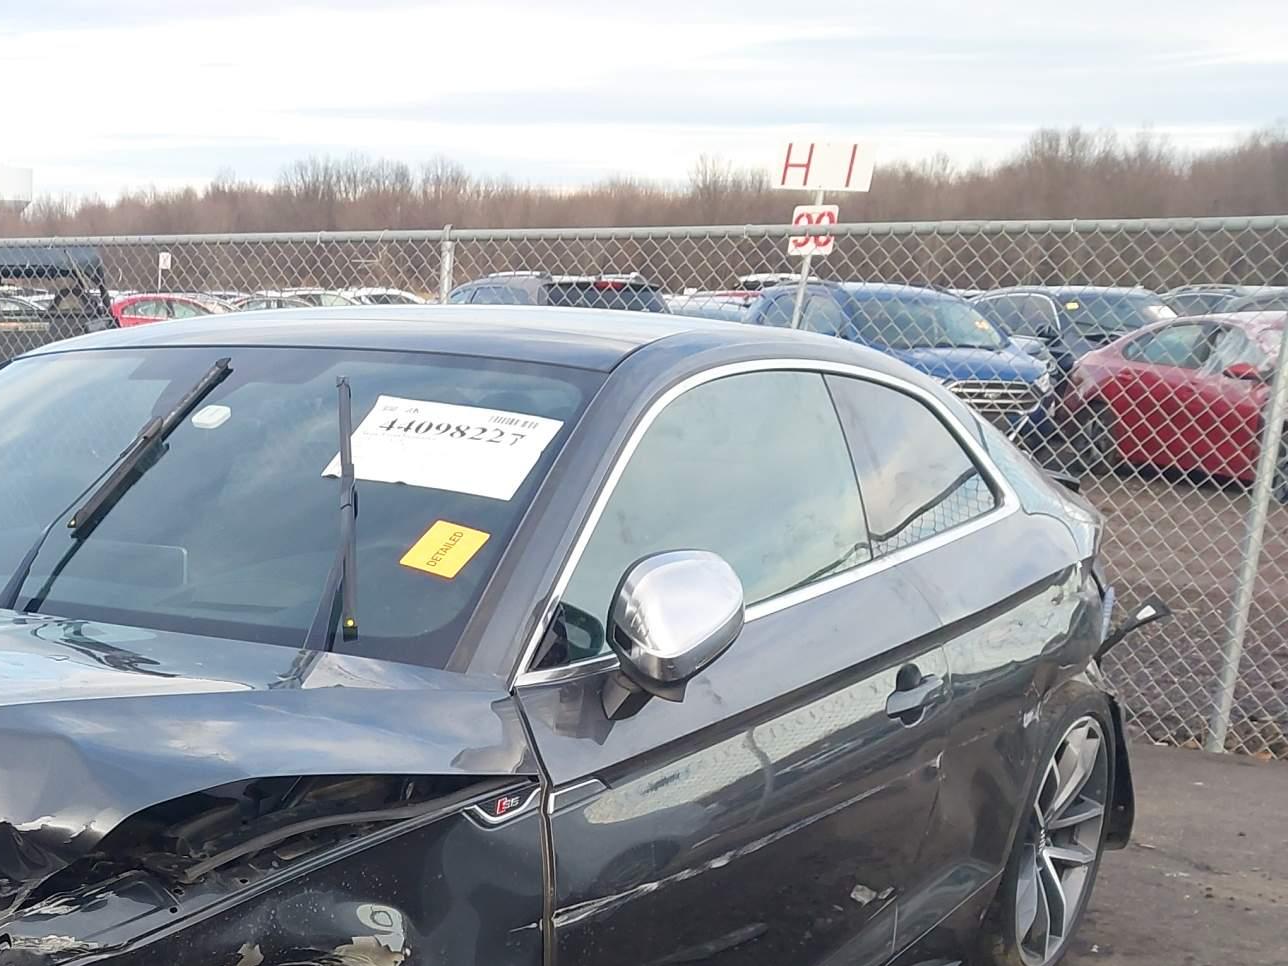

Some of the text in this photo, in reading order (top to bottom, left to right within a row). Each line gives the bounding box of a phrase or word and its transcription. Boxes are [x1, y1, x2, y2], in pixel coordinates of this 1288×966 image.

[780, 143, 815, 186] H
[378, 417, 528, 446] 44098227
[425, 530, 464, 567] DETAILED
